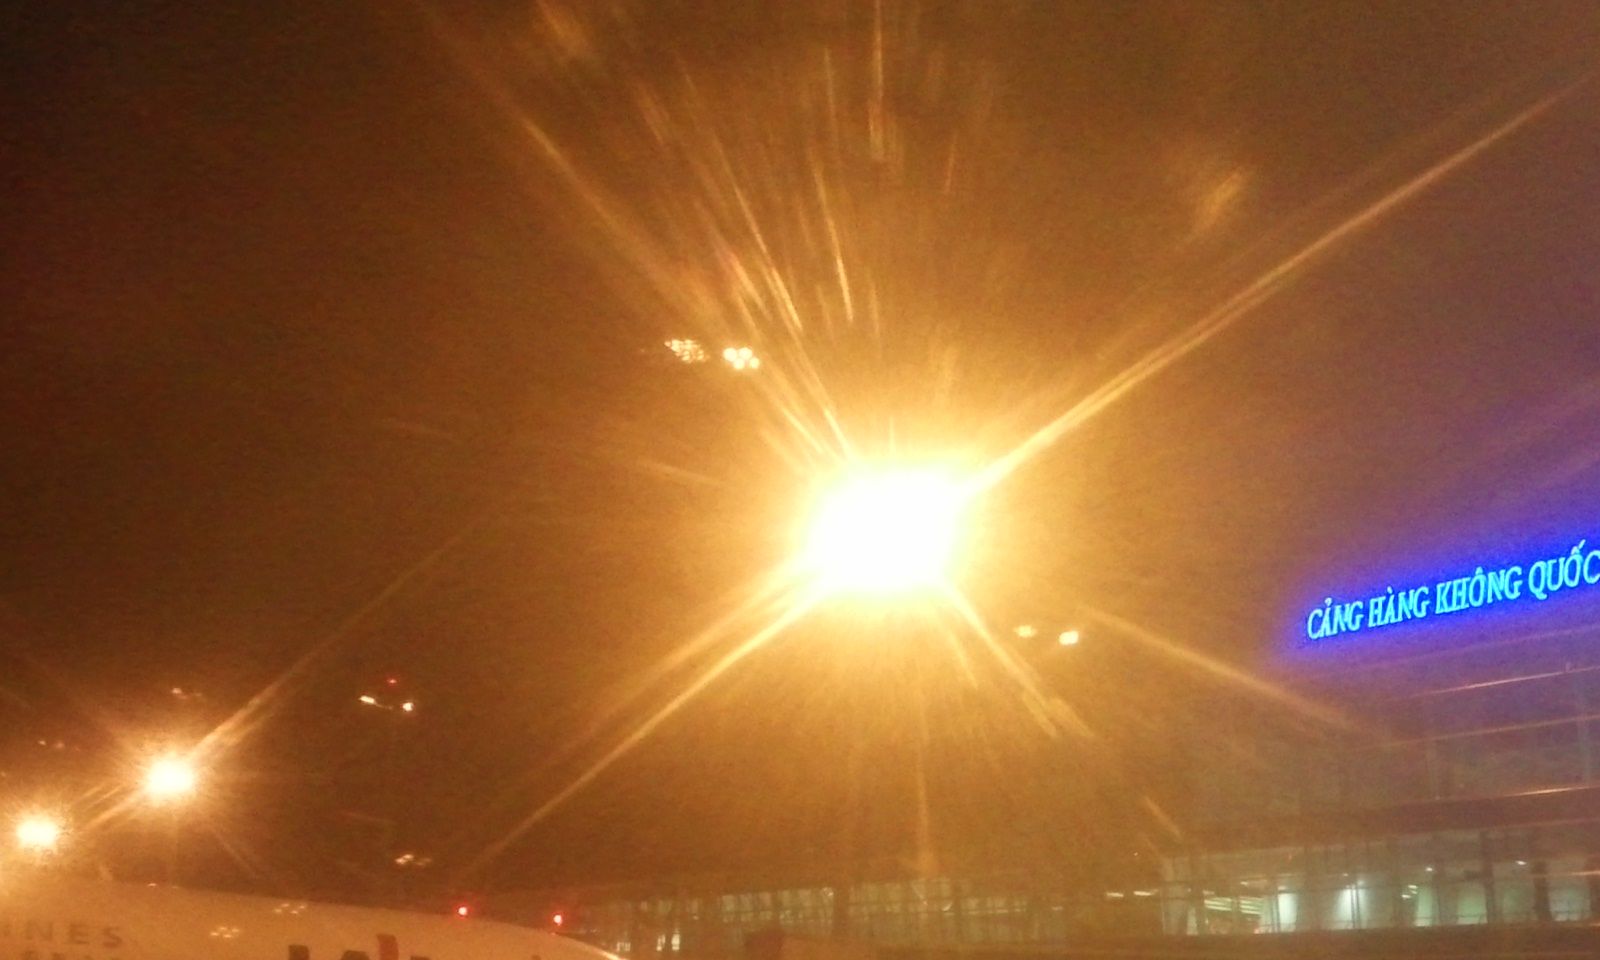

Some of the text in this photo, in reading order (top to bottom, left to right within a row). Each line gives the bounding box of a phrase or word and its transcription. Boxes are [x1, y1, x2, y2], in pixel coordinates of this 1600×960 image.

[1307, 597, 1365, 640] CẢNG
[1367, 585, 1431, 628] HÀNG
[1434, 565, 1523, 615] KHÔNG
